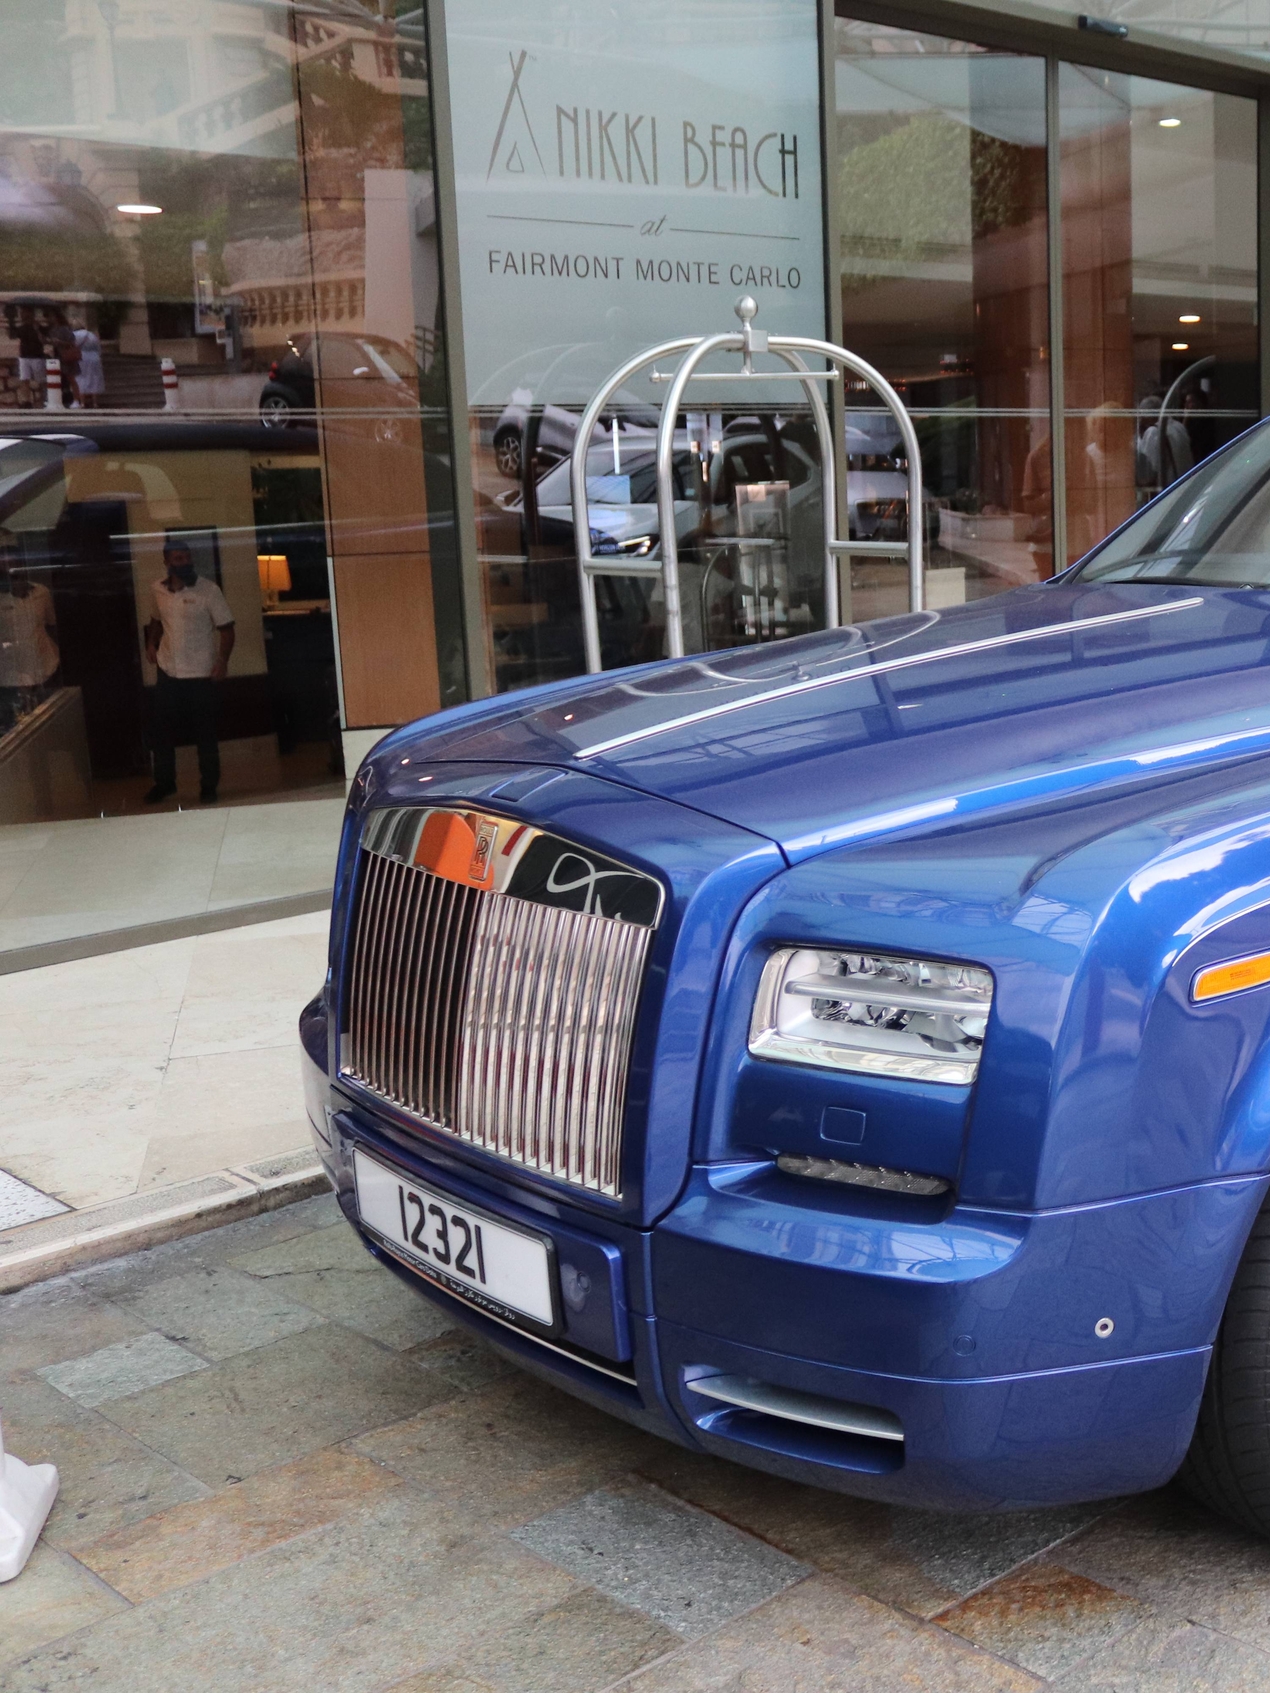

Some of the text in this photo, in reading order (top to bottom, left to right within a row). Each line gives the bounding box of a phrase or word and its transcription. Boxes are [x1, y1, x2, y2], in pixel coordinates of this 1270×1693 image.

[555, 104, 799, 199] NIKKI BEACH
[640, 214, 667, 237] at
[488, 250, 801, 290] FAIRMONT MONTE CARLO
[398, 1184, 487, 1285] 12321
